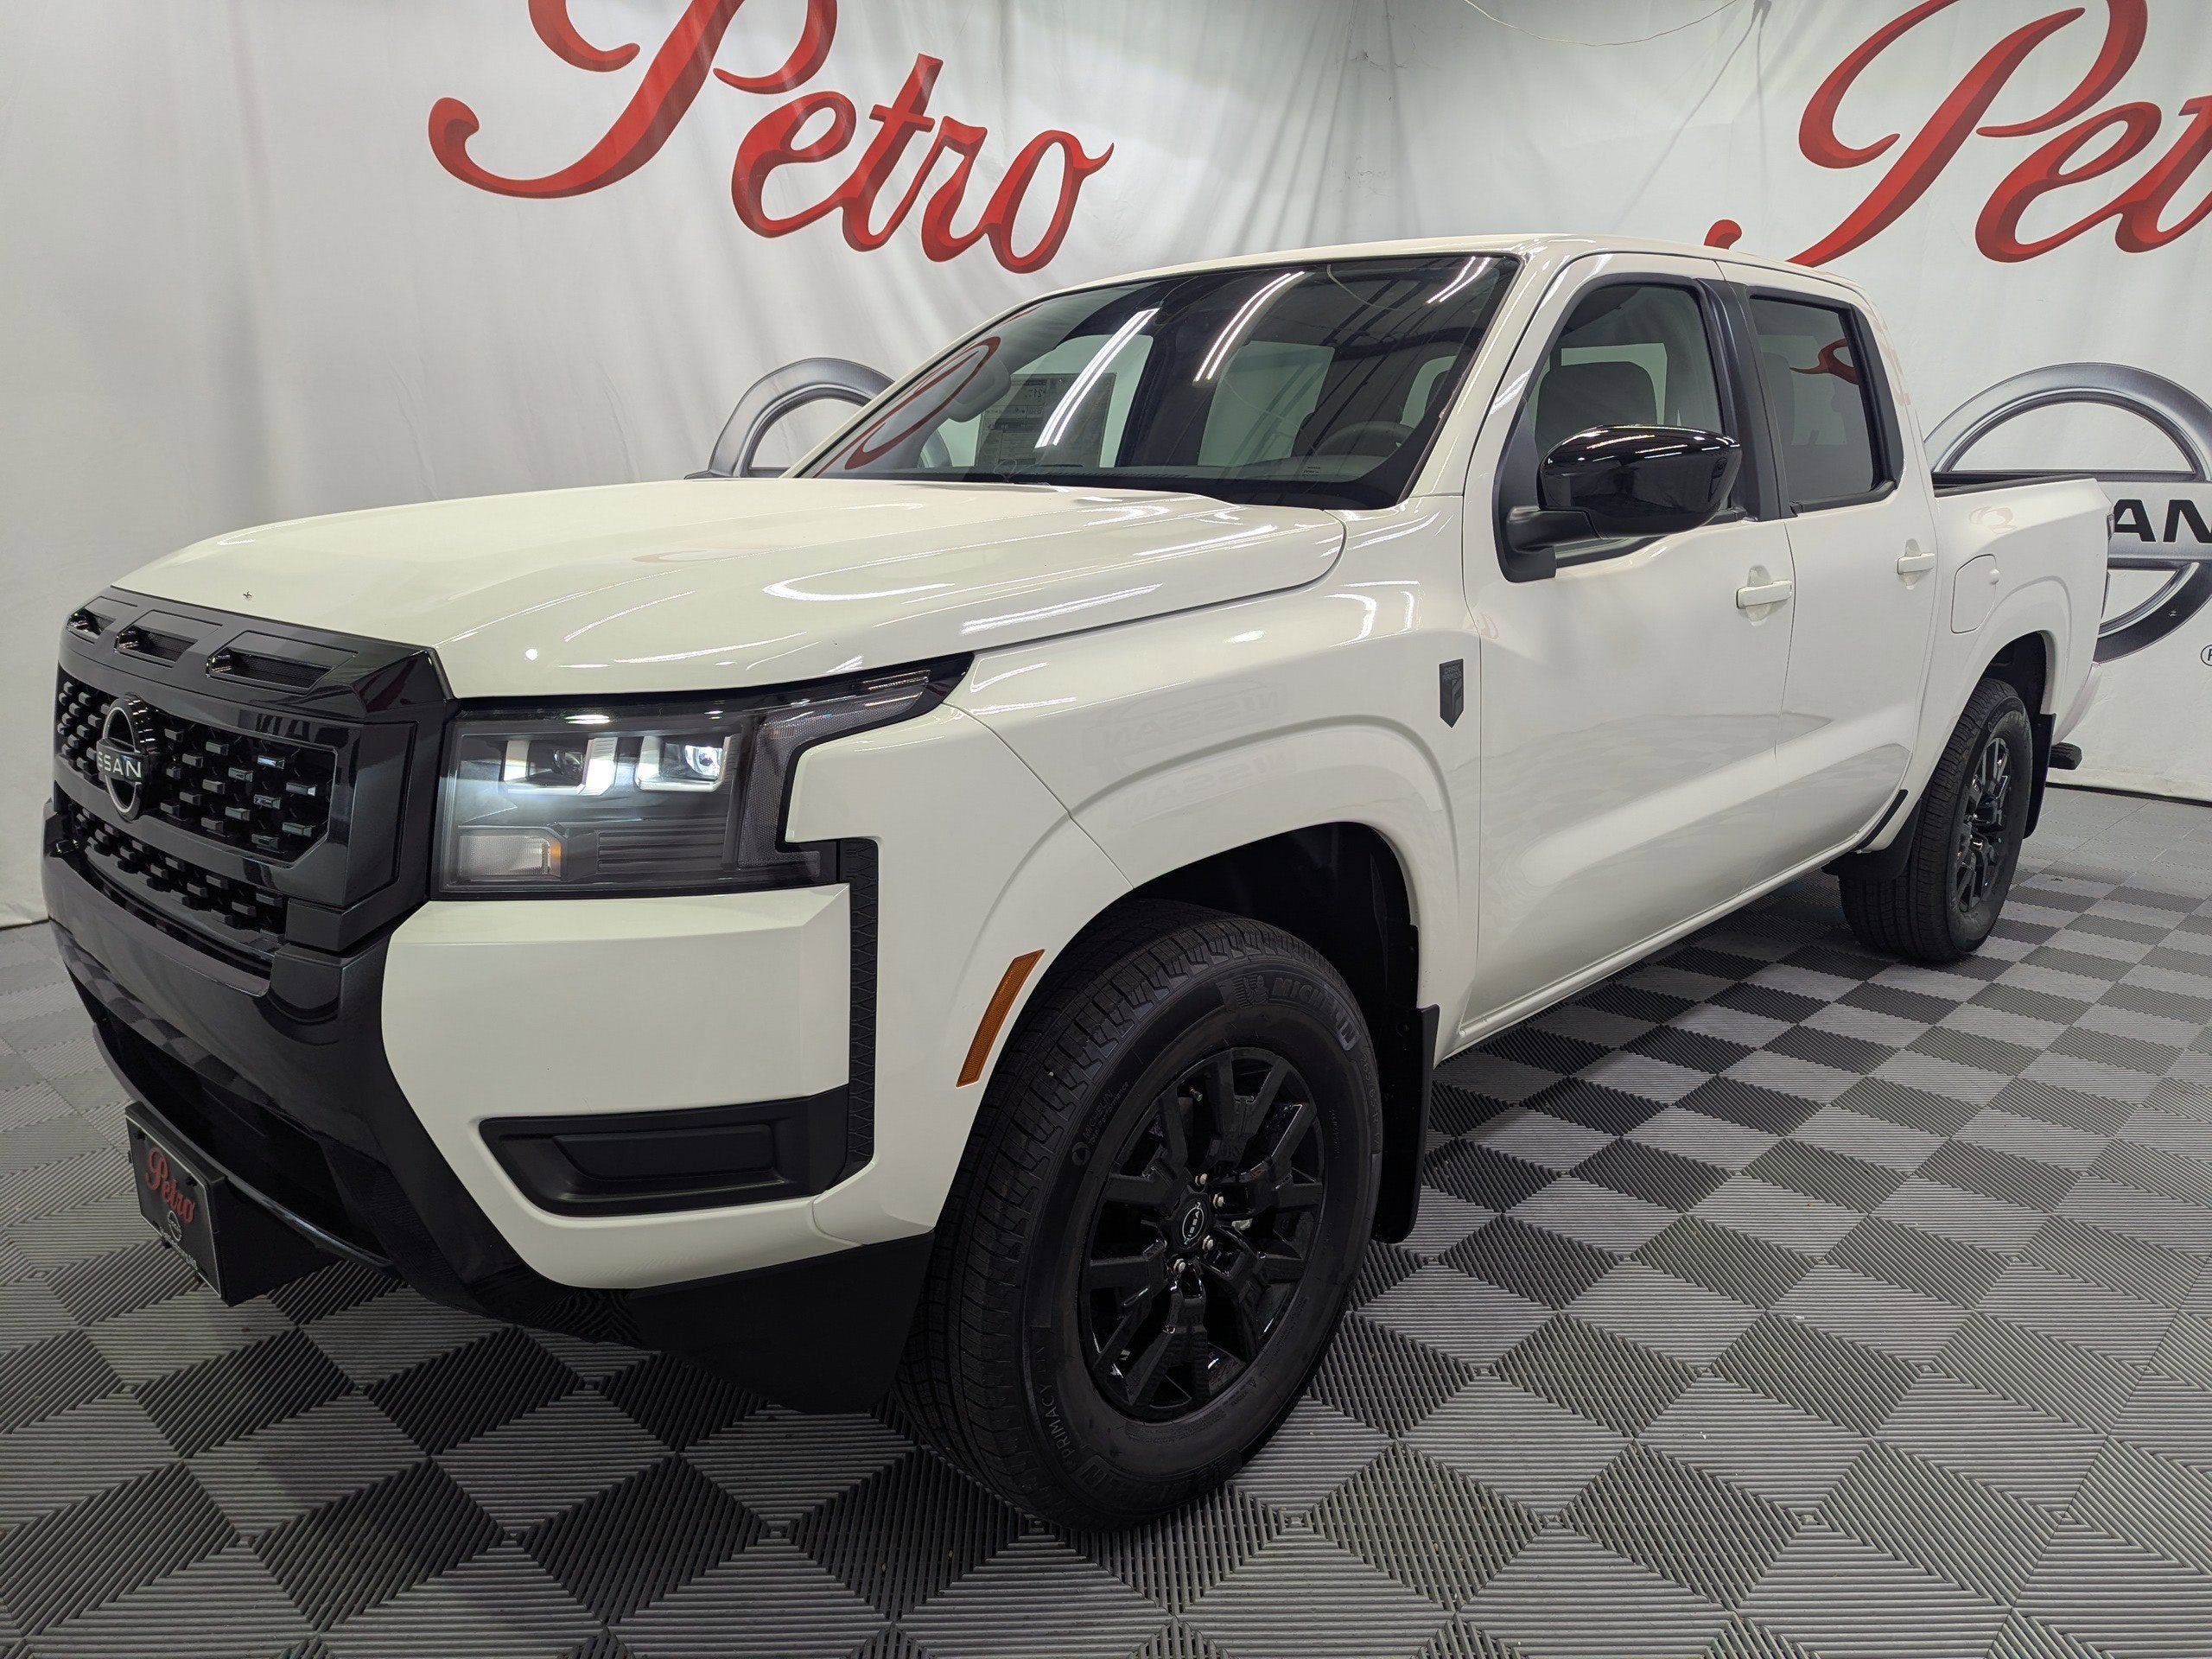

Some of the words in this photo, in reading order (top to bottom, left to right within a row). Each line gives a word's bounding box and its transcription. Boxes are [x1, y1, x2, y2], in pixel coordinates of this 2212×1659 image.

[429, 0, 1115, 274] Petro
[144, 1146, 196, 1225] Petro
[1039, 1382, 1076, 1459] PRIMACY
